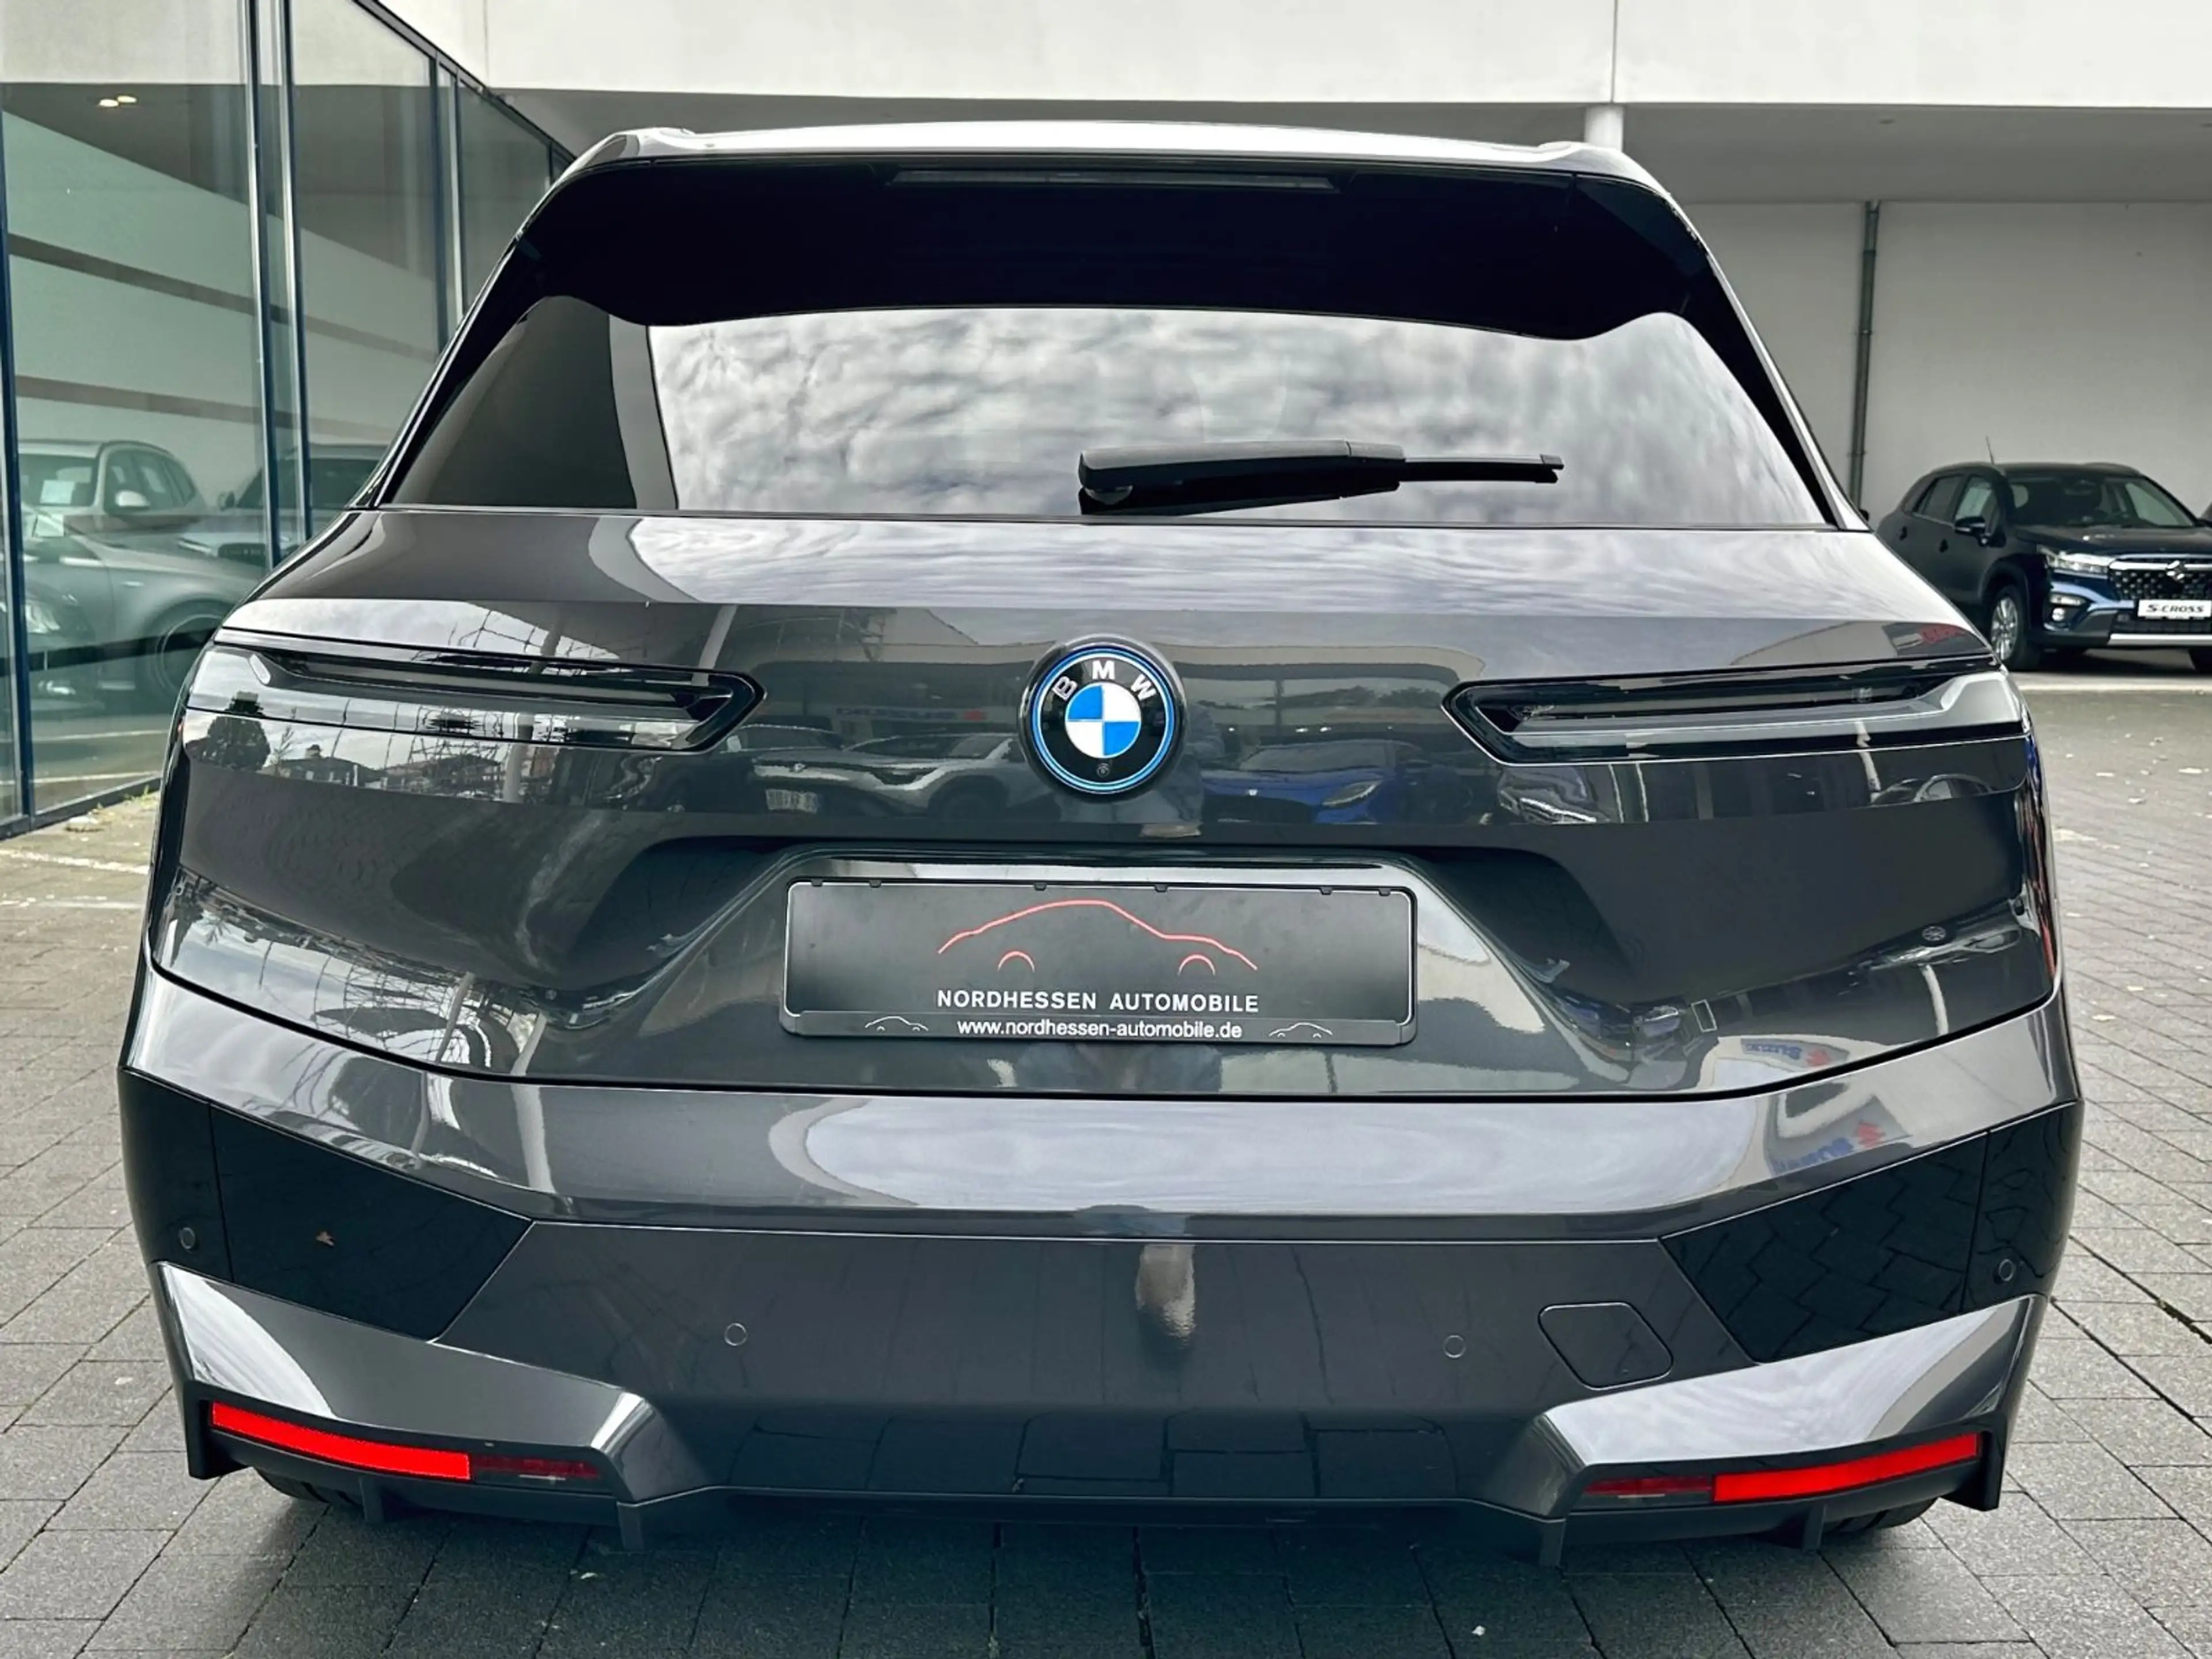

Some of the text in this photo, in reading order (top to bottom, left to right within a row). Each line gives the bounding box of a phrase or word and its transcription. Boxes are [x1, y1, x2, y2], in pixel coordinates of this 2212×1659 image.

[1052, 660, 1157, 700] BMW
[937, 990, 1259, 1012] NORDHESSEN AUTOMOBILE
[957, 1019, 1243, 1037] www.nordhessen-automobile.de
